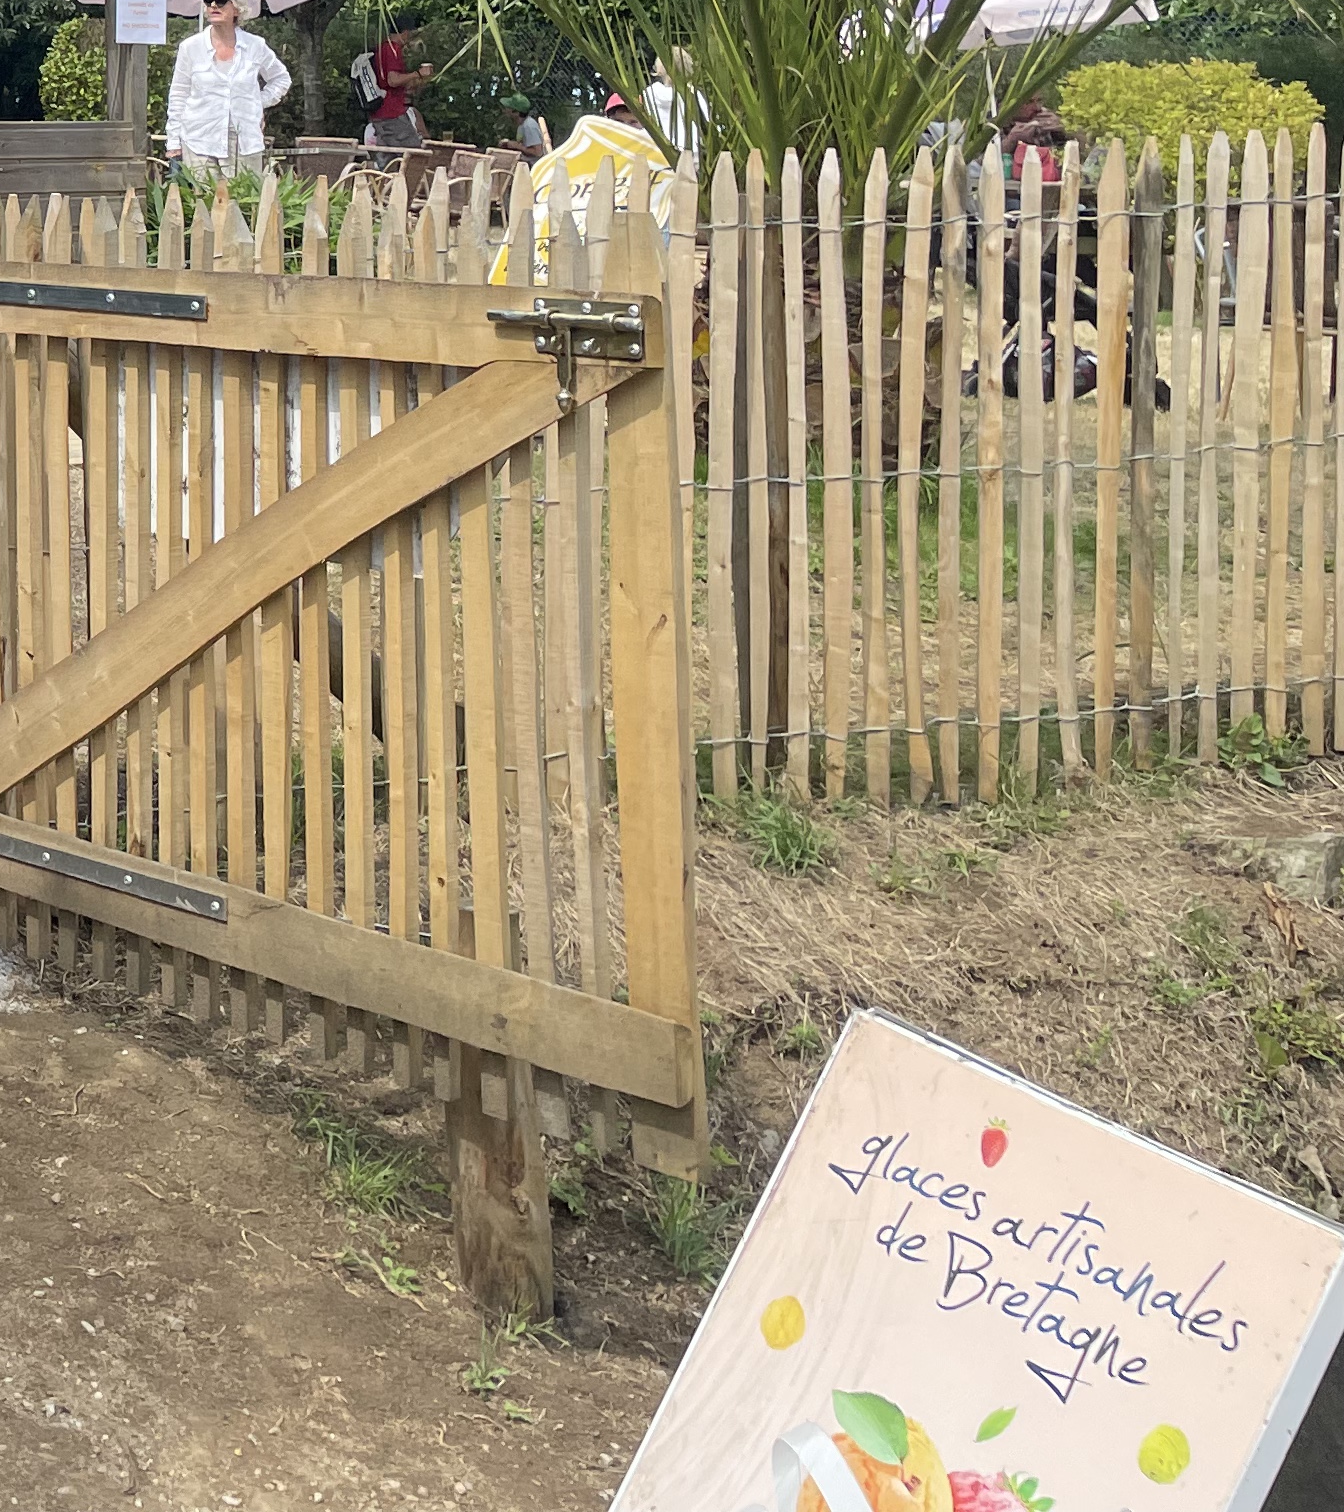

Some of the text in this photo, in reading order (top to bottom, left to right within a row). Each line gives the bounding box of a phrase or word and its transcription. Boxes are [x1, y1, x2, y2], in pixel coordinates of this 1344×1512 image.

[827, 1130, 1250, 1354] glaces artisanales
[875, 1200, 1151, 1406] de Bretagne
